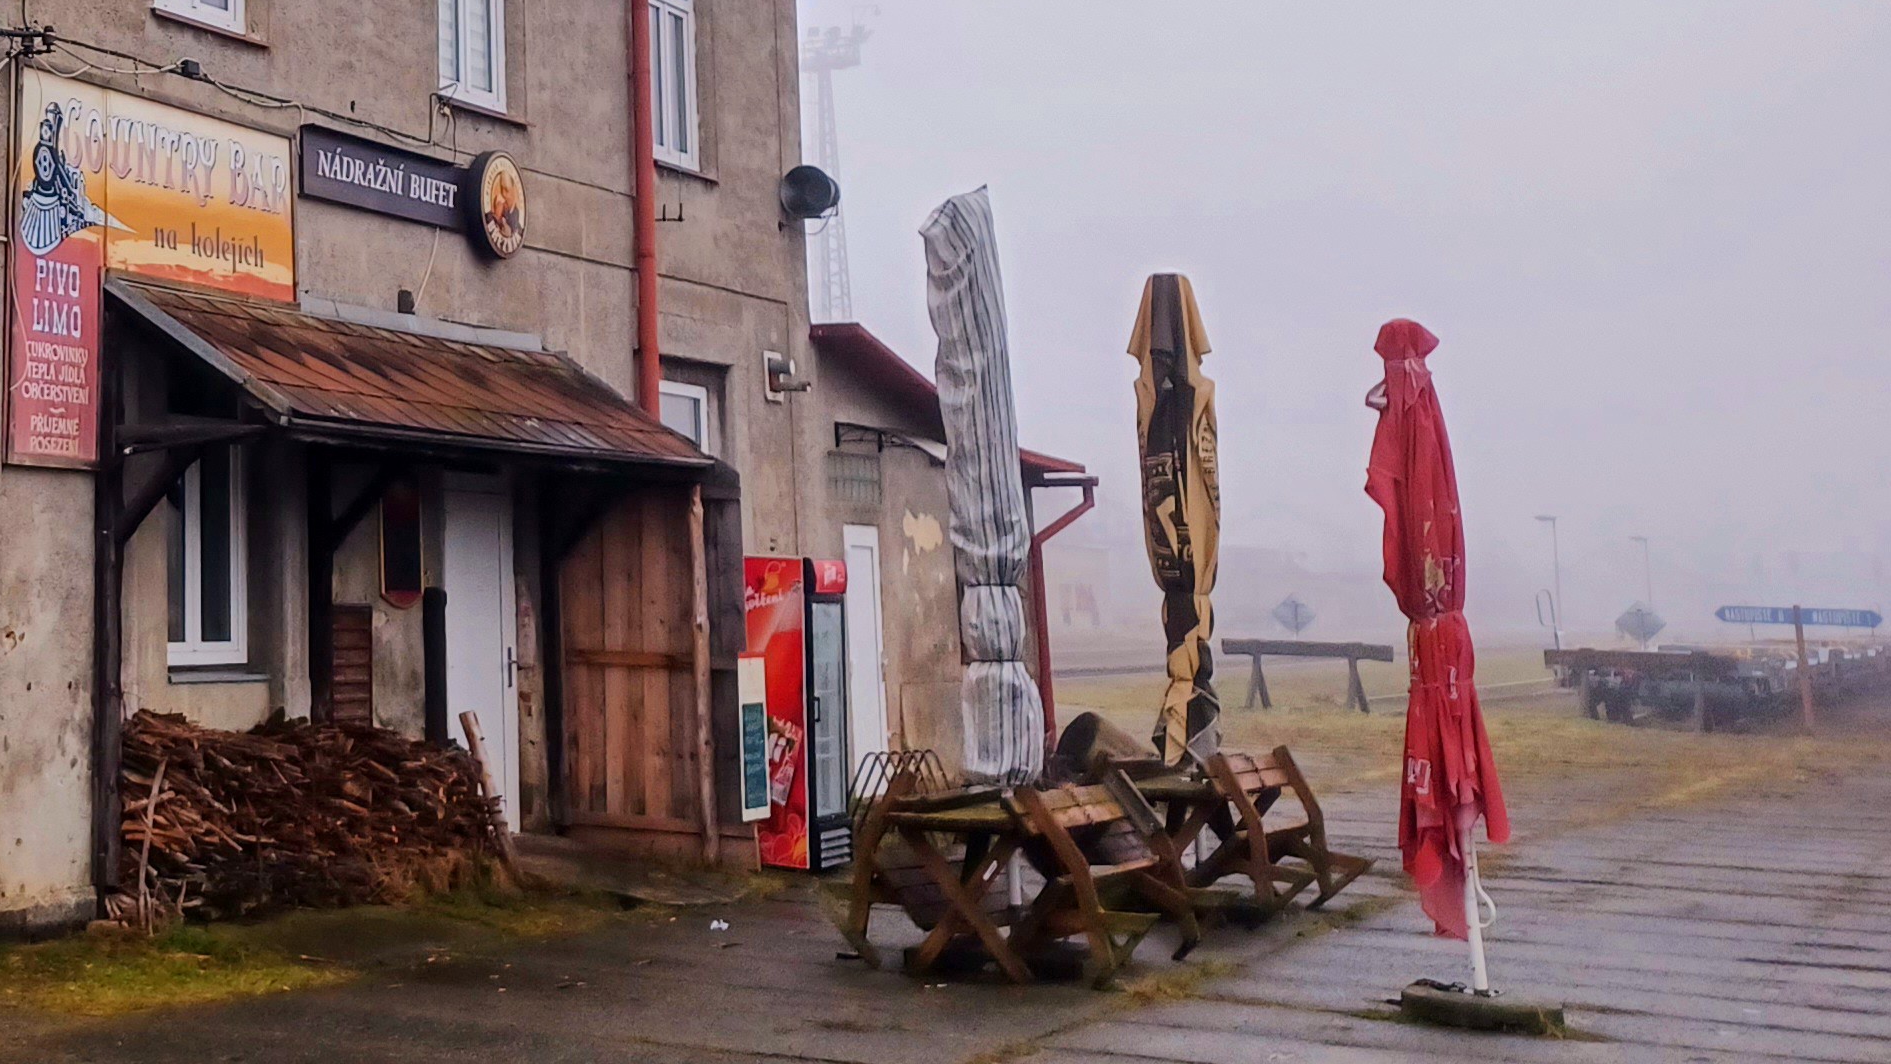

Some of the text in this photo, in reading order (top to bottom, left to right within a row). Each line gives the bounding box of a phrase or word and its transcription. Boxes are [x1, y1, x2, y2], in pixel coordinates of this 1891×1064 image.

[62, 97, 288, 215] COUNTRY BAR
[316, 147, 405, 196] NÁDRAŽNÍ
[409, 173, 458, 208] BUFET
[154, 221, 264, 274] na kolejích
[35, 258, 81, 297] PIVO
[32, 297, 82, 338] LIMO
[27, 340, 89, 367] CUKROVINKY
[21, 380, 90, 404] OBČERSTVENÍ
